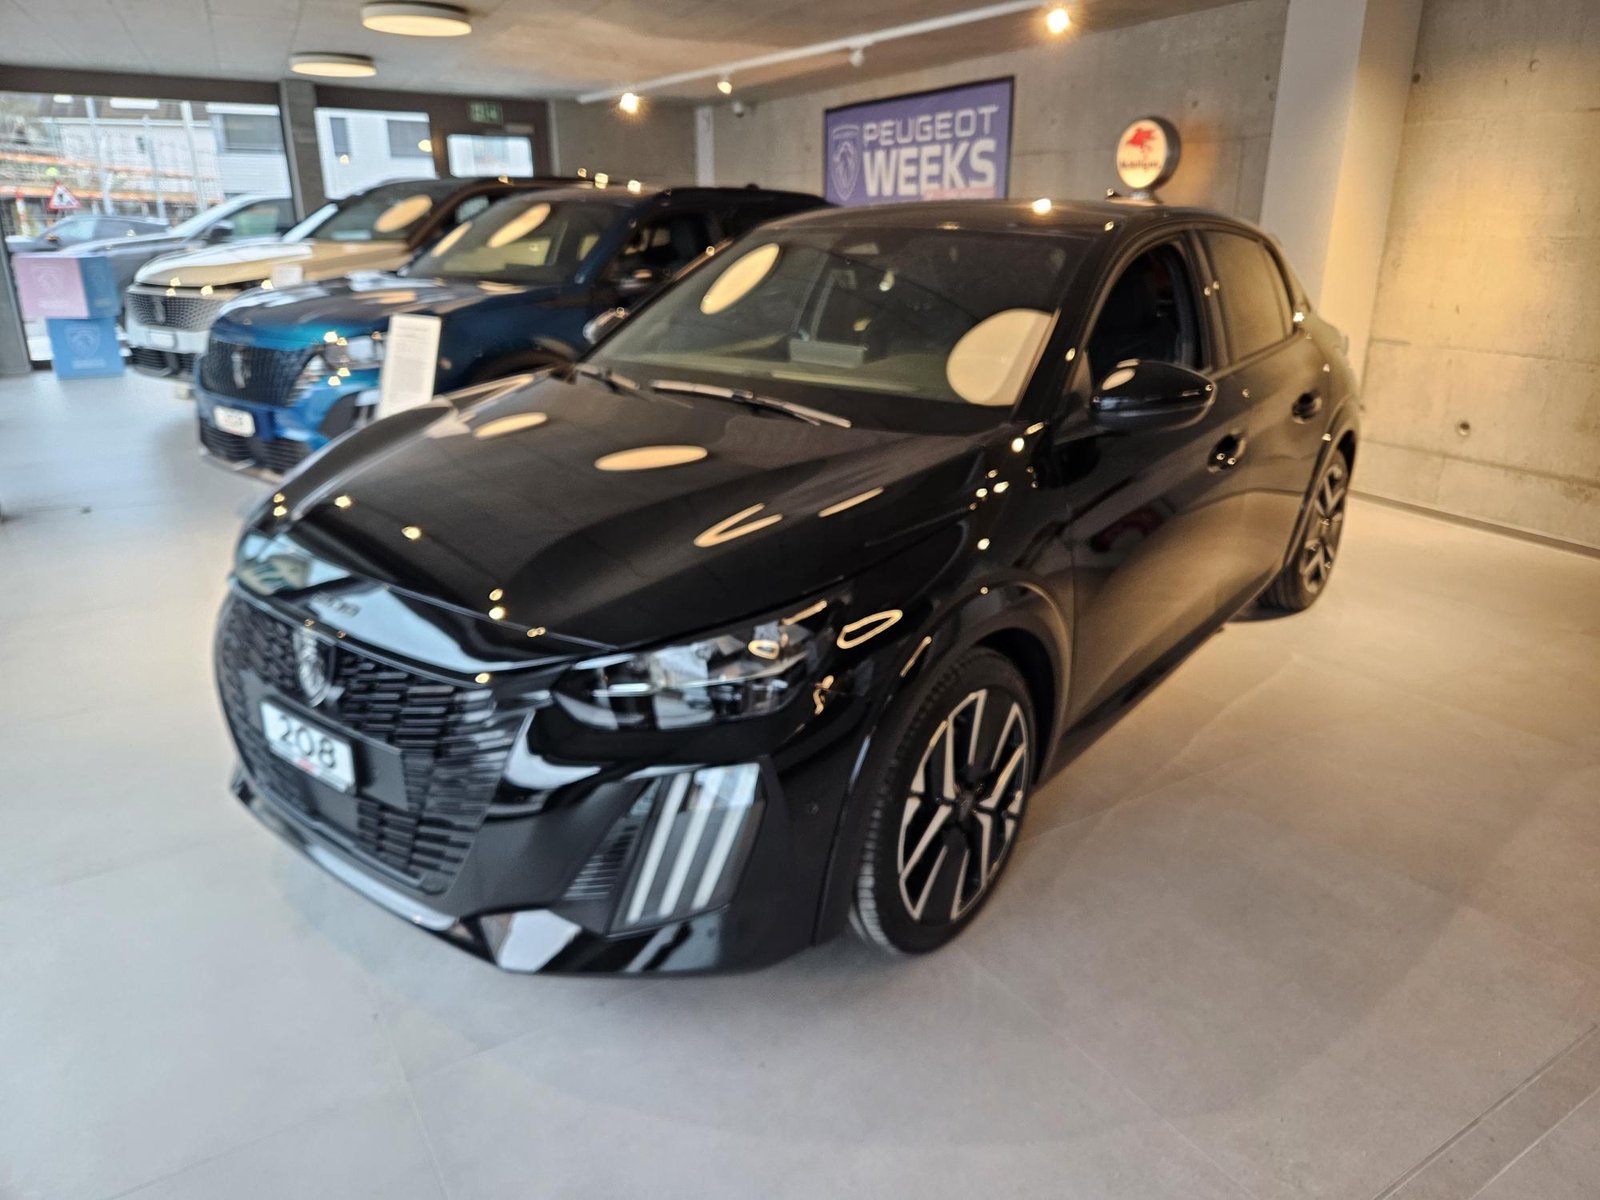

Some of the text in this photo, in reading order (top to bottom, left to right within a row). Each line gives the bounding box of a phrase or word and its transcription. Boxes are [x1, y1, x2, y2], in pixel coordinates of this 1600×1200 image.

[863, 104, 999, 146] PEUGEOT
[863, 138, 997, 197] WEEKS
[280, 714, 336, 769] 208
